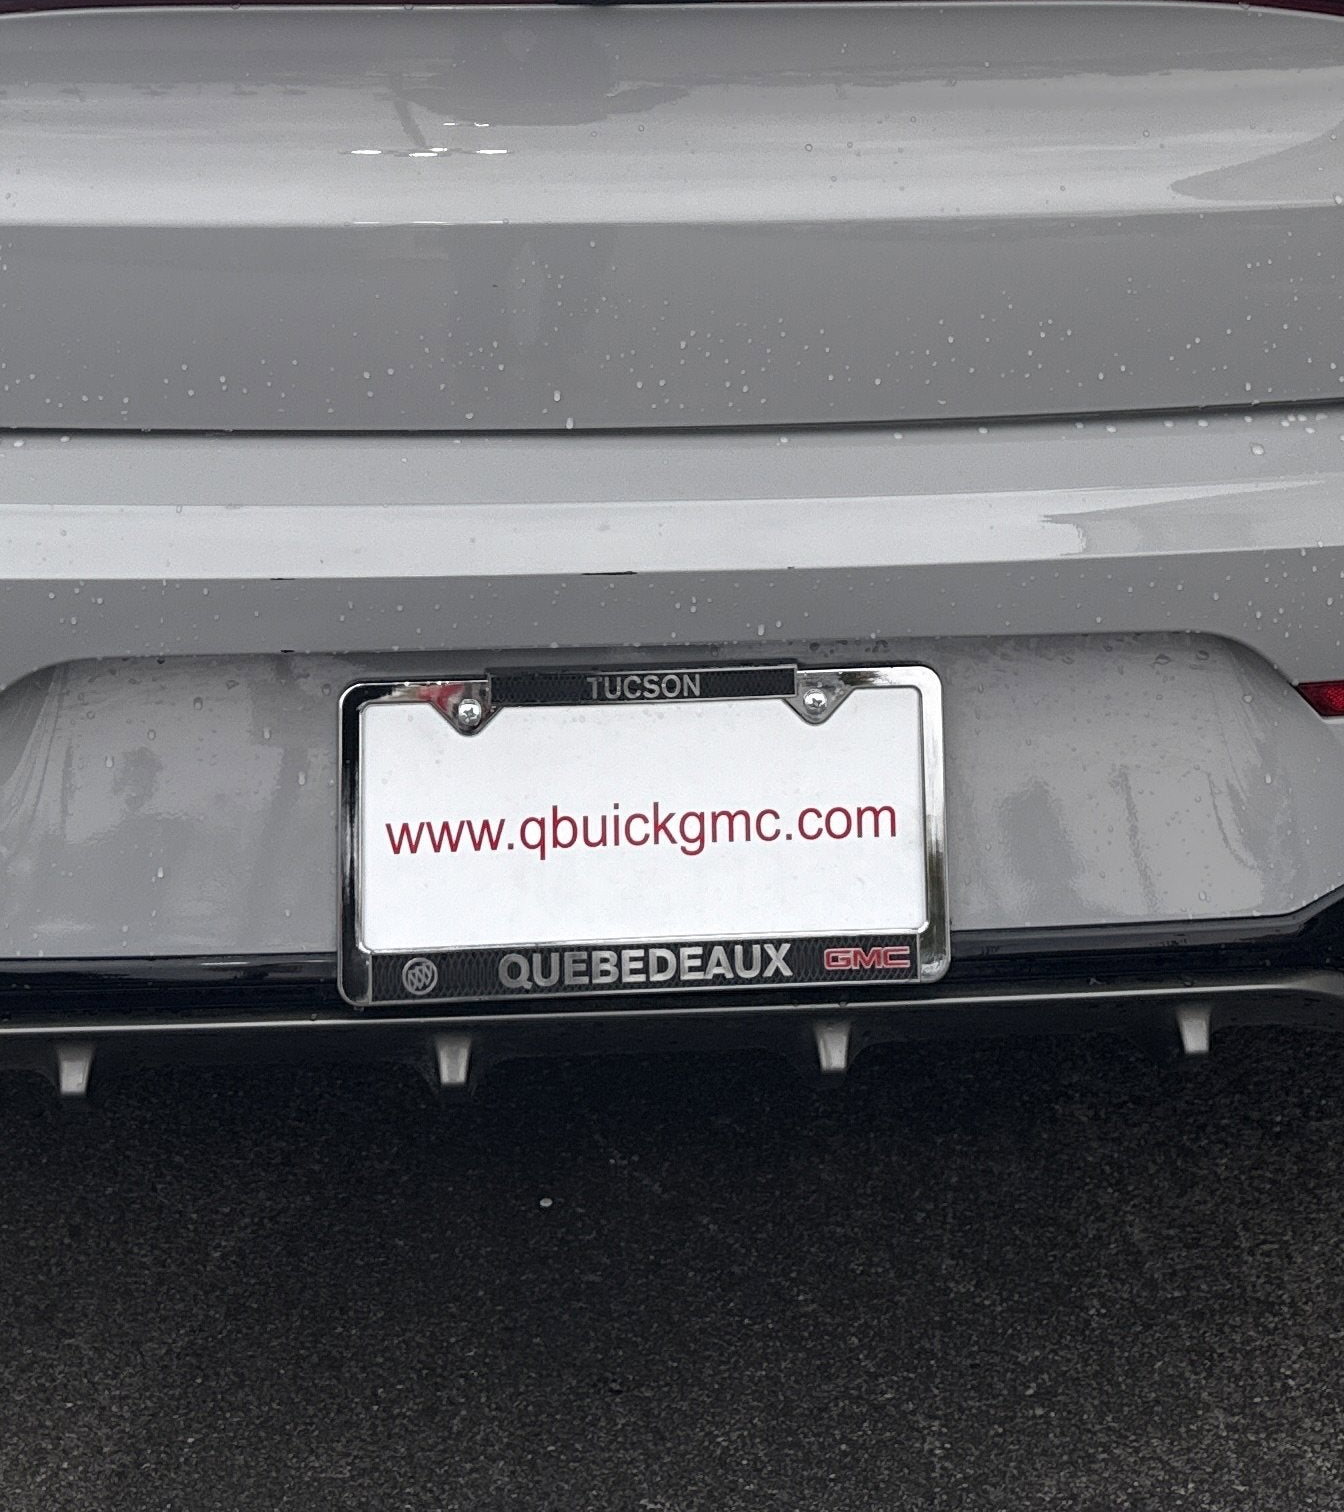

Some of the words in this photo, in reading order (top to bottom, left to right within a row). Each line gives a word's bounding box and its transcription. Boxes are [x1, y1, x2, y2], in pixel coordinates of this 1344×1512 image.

[586, 673, 701, 700] TUCSON
[385, 802, 898, 860] www.qbuickgmc.com
[498, 942, 794, 991] QUEBEDEAUX
[823, 945, 911, 970] GMC
